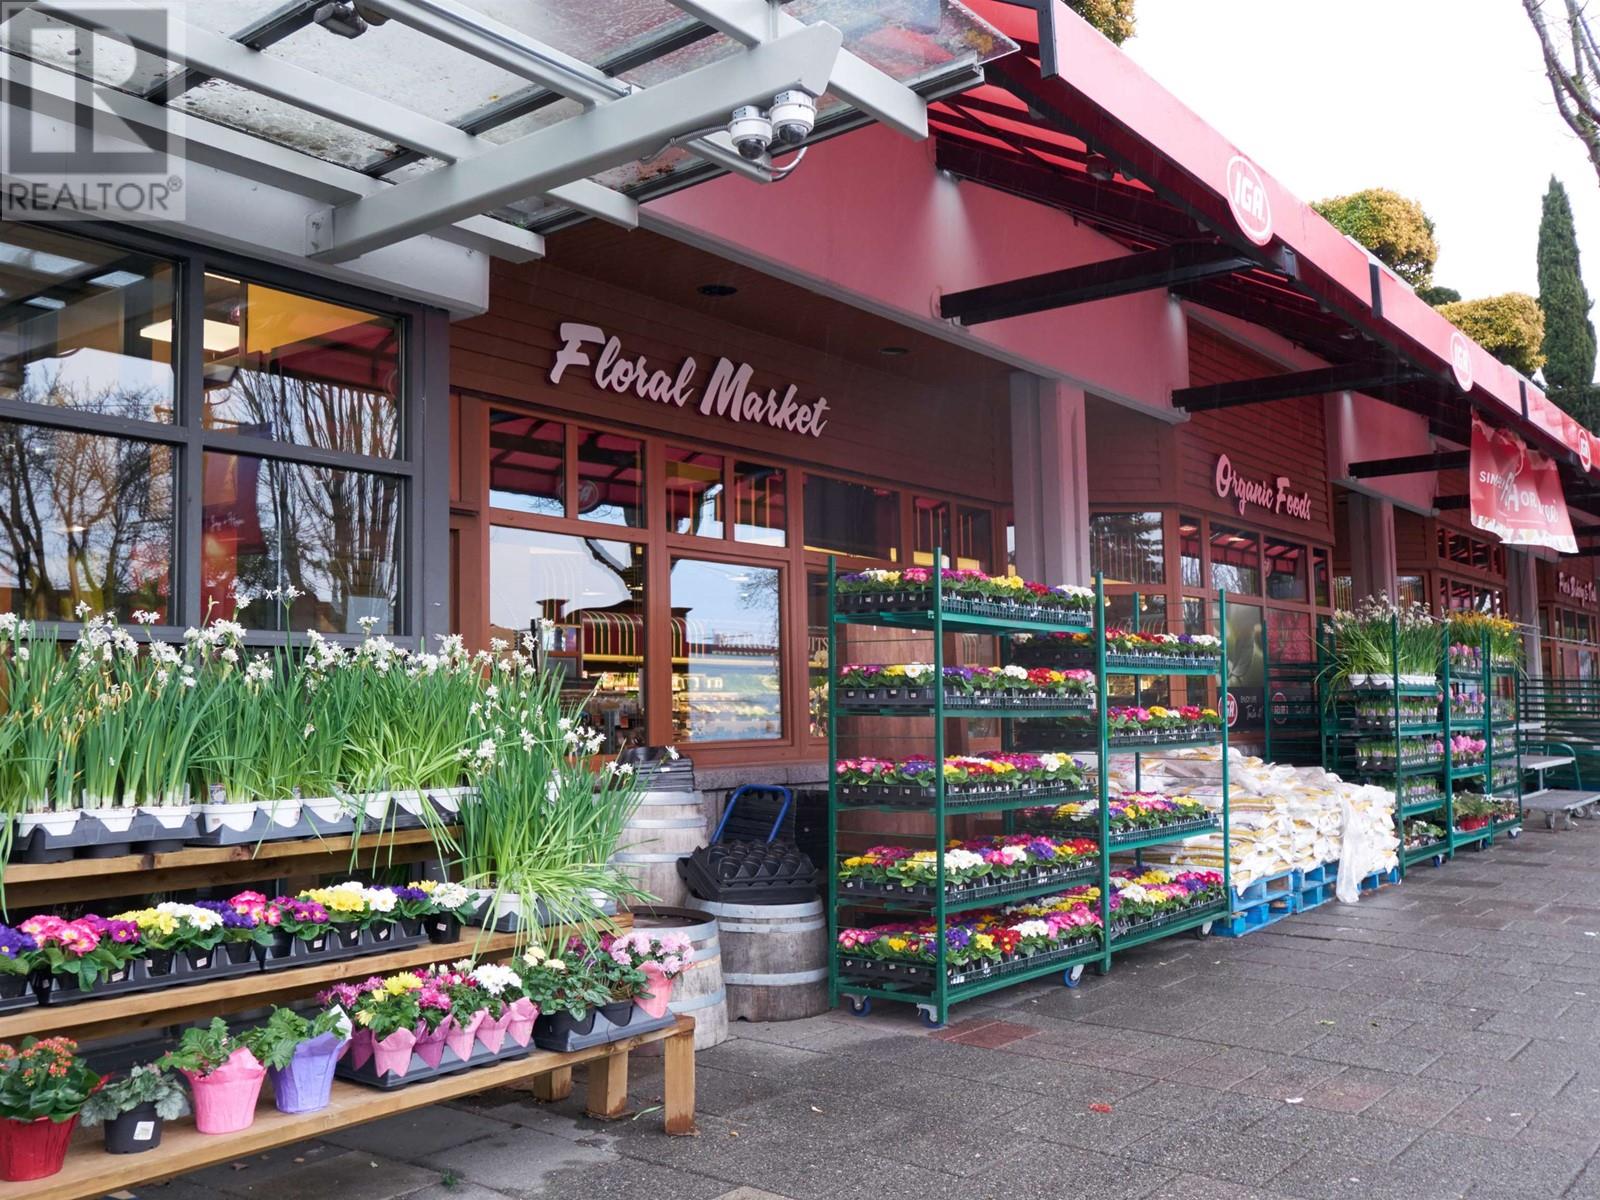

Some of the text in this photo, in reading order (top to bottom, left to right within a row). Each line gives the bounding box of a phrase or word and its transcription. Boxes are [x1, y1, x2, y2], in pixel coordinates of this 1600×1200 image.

[1234, 171, 1264, 220] IGA
[550, 322, 831, 437] Floral Market
[1216, 454, 1311, 520] Organic Foods
